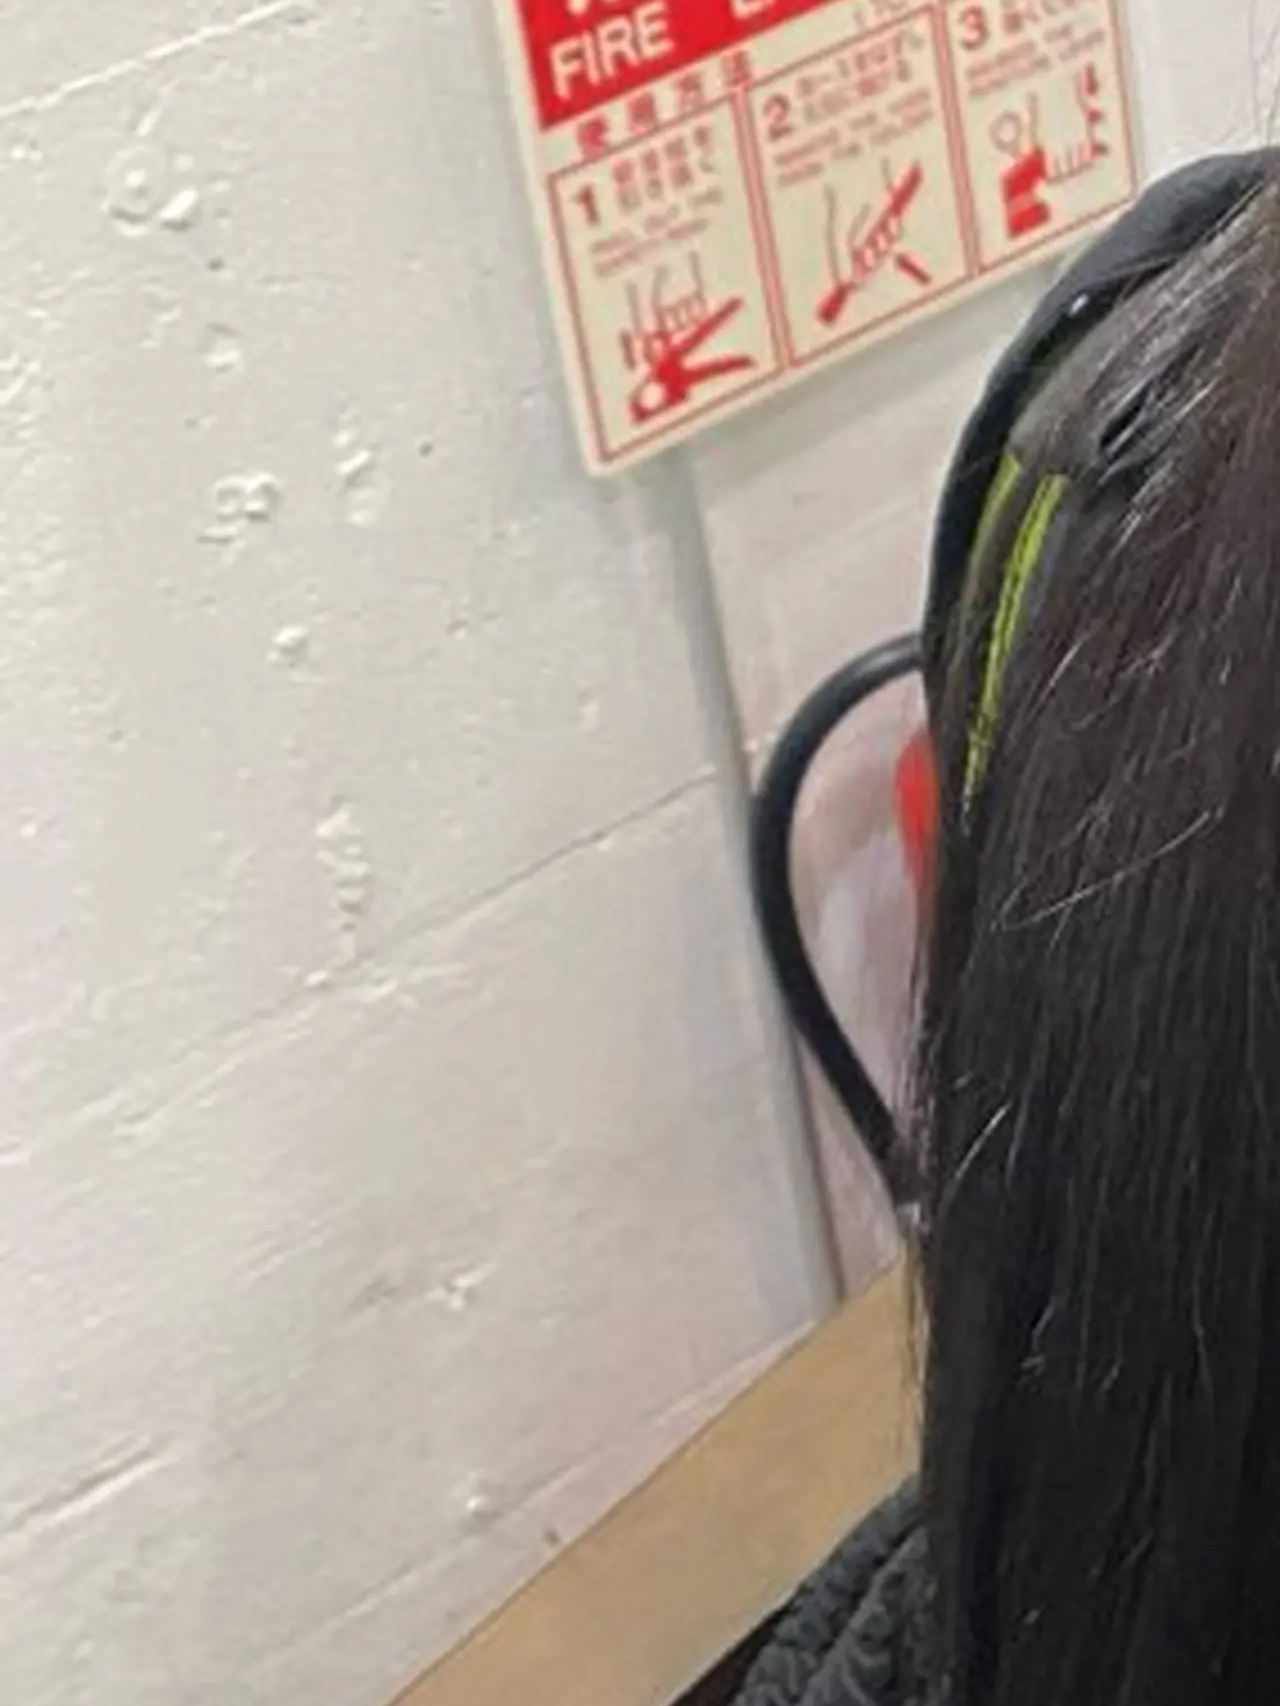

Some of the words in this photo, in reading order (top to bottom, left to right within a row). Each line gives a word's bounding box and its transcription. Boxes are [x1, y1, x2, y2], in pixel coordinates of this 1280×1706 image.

[960, 4, 992, 50] 3
[549, 0, 674, 101] FIRE
[762, 94, 794, 139] 2
